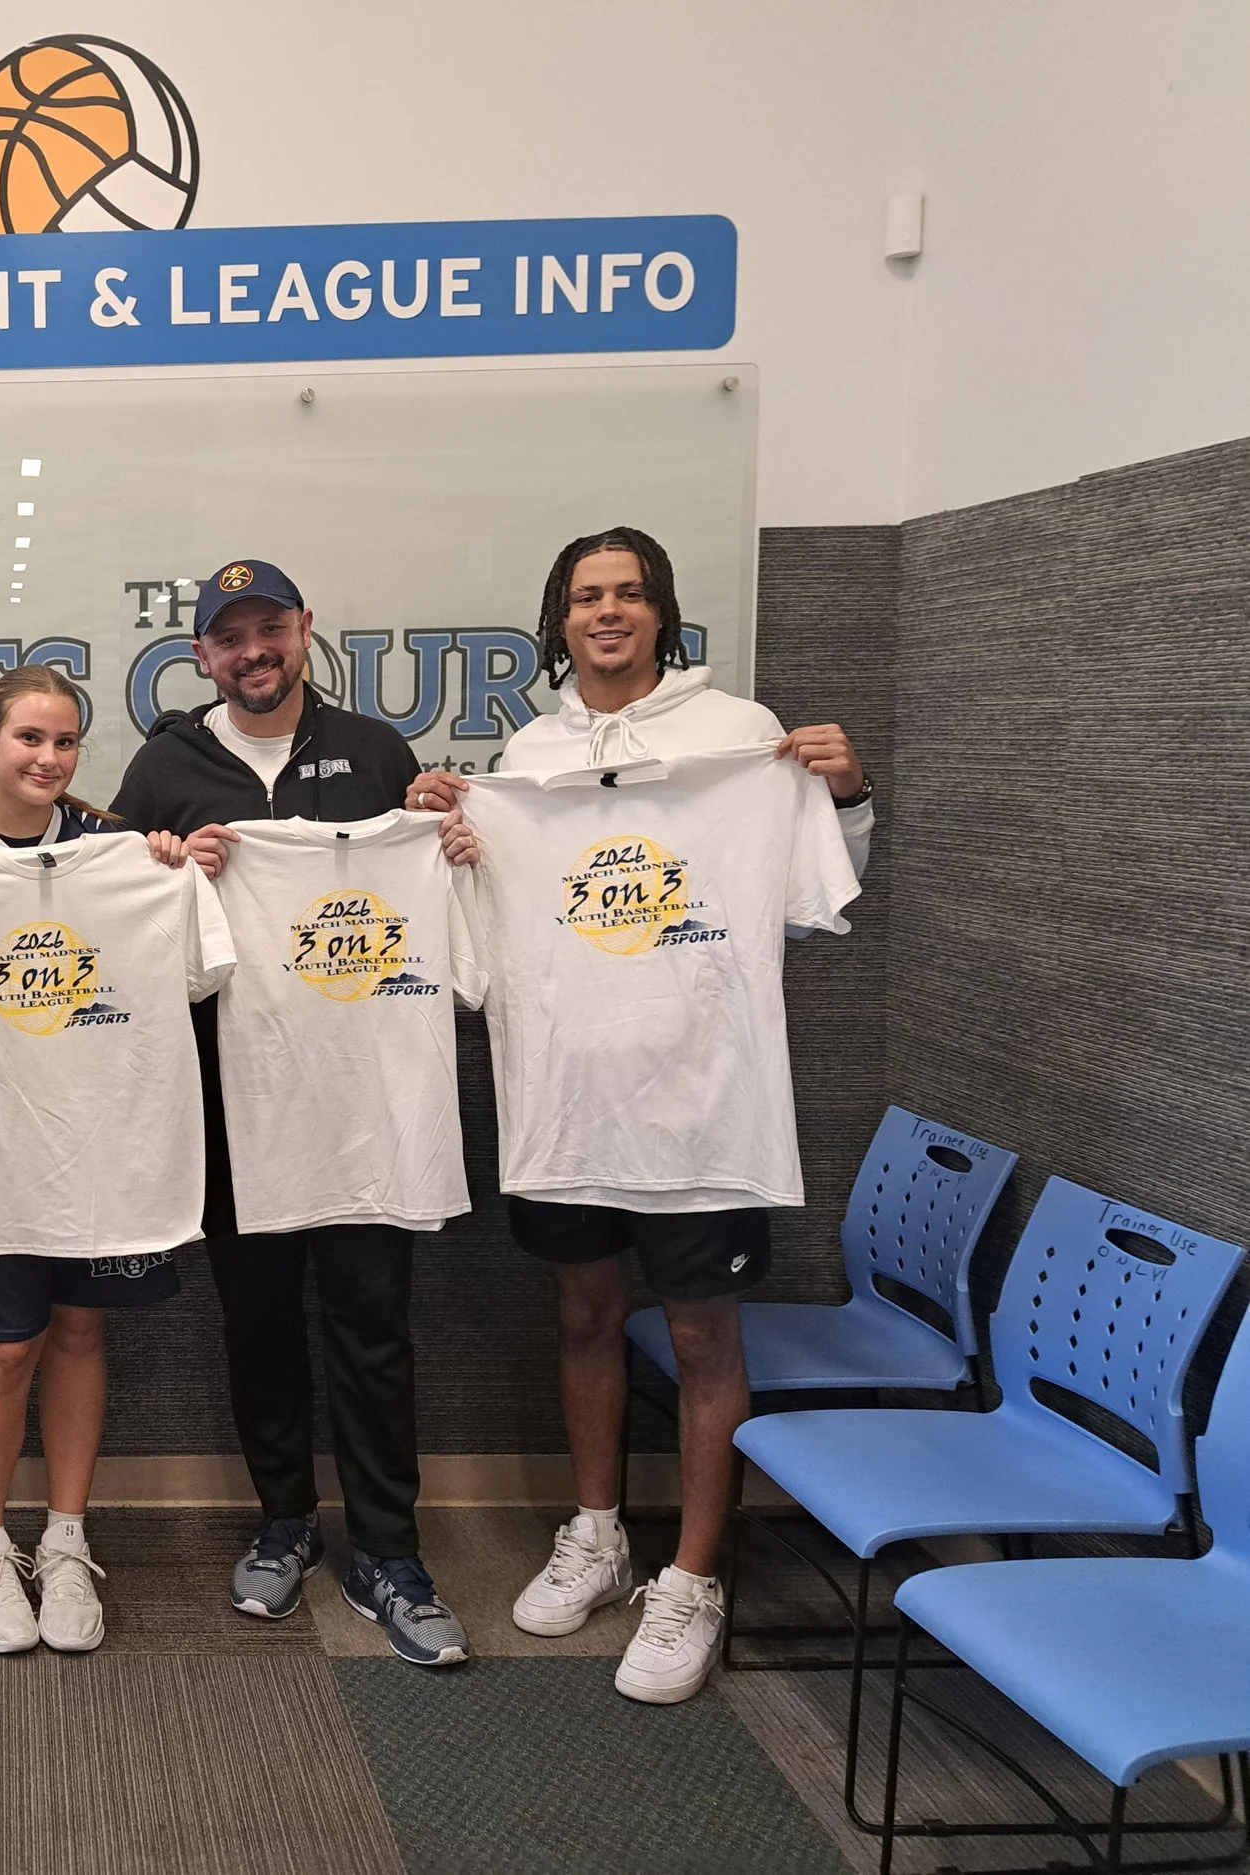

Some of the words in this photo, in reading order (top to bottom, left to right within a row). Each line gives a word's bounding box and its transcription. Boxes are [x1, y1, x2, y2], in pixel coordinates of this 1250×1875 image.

[90, 268, 141, 327] &
[171, 259, 481, 324] LEAGUE
[516, 252, 694, 314] INFO
[125, 580, 209, 628] TH
[298, 758, 352, 780] LIONS
[589, 844, 646, 869] 2026
[562, 871, 613, 884] MARCH
[618, 859, 688, 874] MADNESS
[569, 881, 589, 916] 3
[601, 882, 649, 909] on
[659, 868, 682, 903] 3
[317, 898, 370, 920] 2026
[555, 912, 607, 926] YOUTH
[613, 901, 708, 917] BASKETBALL
[290, 922, 340, 932] MARCH
[345, 916, 409, 927] MADNESS
[601, 914, 662, 928] LEAGUE
[12, 930, 64, 951] 2026
[295, 931, 316, 963] 3
[328, 934, 372, 958] on
[380, 924, 402, 956] 3
[39, 948, 101, 959] MADNESS
[282, 962, 332, 972] YOUTH
[338, 956, 425, 967] BASKETBALL
[22, 966, 64, 990] on
[73, 955, 94, 987] 3
[326, 965, 381, 976] LEAGUE
[20, 997, 74, 1008] LEAGUE
[32, 986, 116, 1000] BASKETBALL
[968, 1142, 989, 1160] Use
[1099, 1199, 1165, 1237] Trainer
[1170, 1230, 1198, 1256] Use
